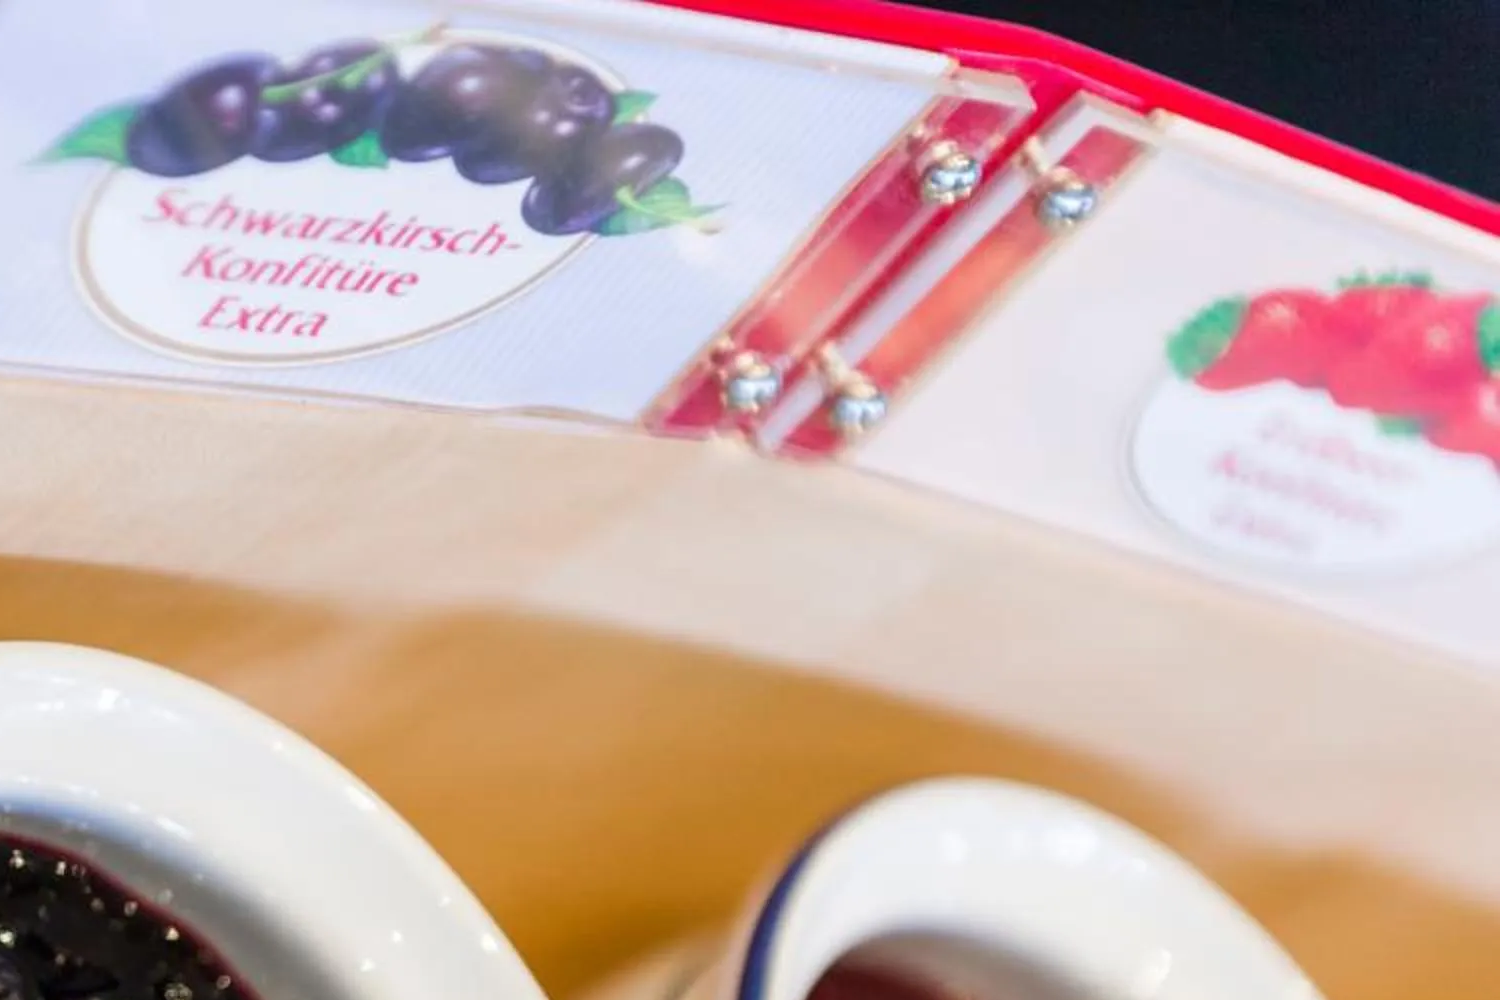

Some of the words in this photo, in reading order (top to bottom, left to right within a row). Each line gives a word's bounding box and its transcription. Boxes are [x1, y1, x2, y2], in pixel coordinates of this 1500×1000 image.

[143, 188, 520, 256] Schwarzkirsch-
[182, 244, 419, 296] Konfitüre
[198, 296, 328, 337] Extra
